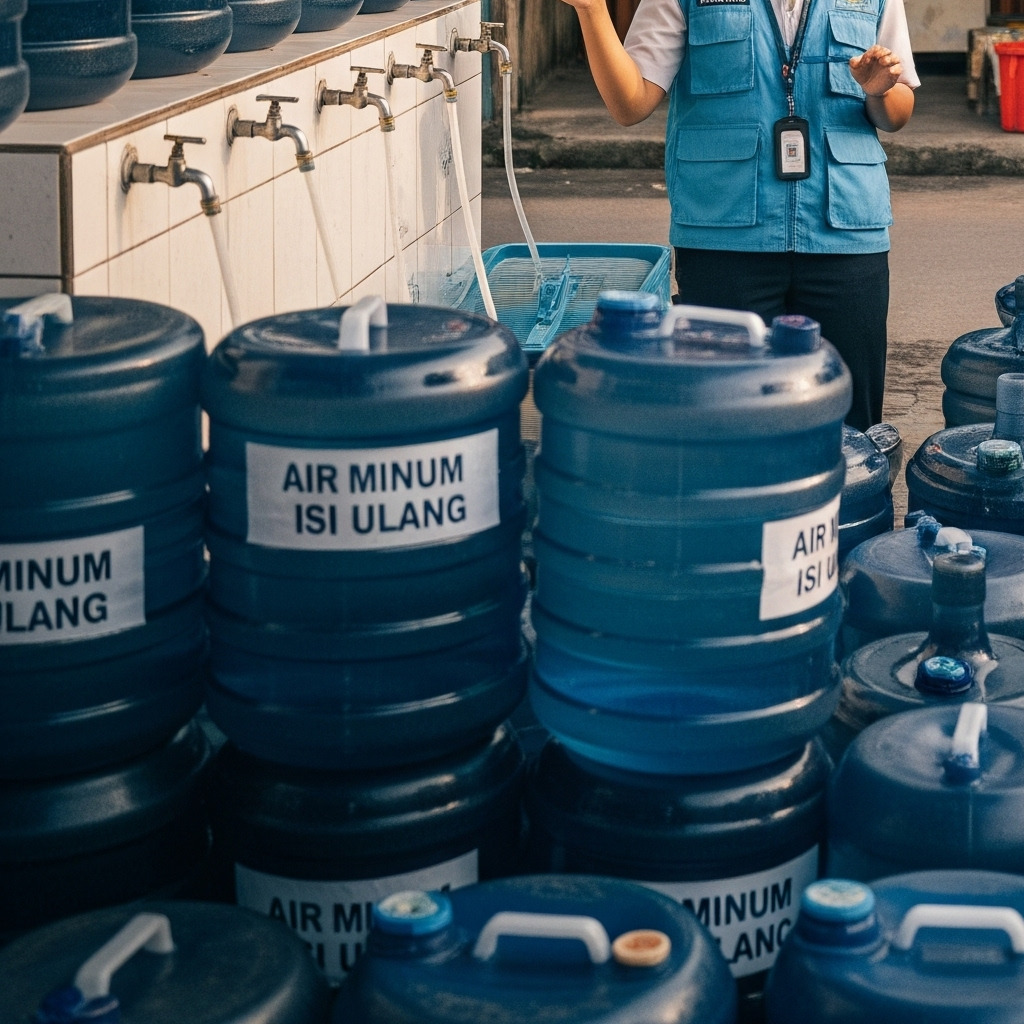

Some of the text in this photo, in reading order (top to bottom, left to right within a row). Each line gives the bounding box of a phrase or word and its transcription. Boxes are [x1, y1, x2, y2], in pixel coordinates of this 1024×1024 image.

[283, 454, 463, 494] AIR MINUM
[295, 494, 467, 535] ISI ULANG
[792, 523, 826, 561] AIR
[797, 561, 822, 596] ISI
[0, 593, 107, 633] LANG
[269, 897, 323, 933] AIR
